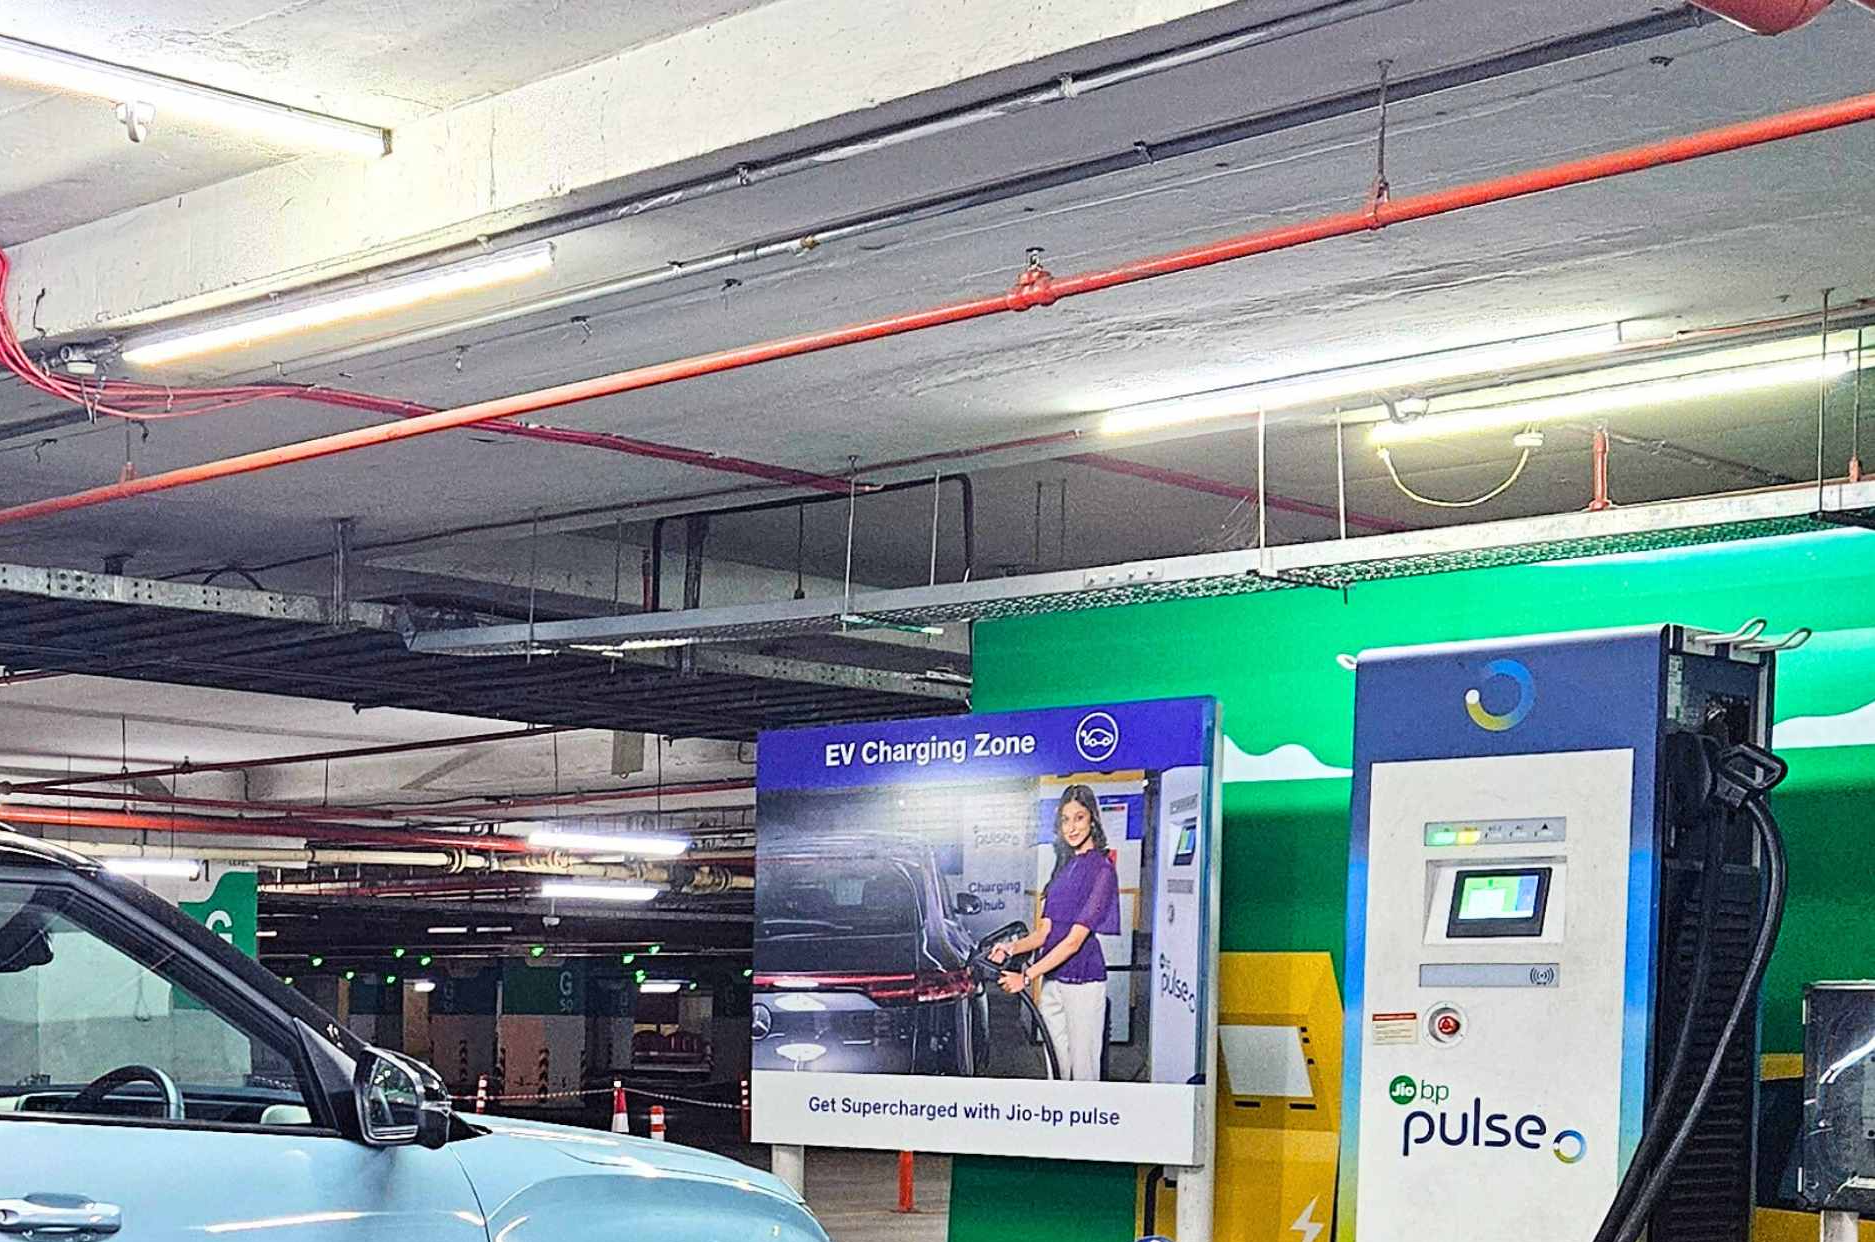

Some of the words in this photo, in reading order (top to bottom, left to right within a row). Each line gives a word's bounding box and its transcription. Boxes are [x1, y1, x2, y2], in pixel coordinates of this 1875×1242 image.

[825, 743, 855, 767] EV
[861, 736, 967, 765] Charging
[974, 732, 1036, 757] Zone
[968, 881, 1021, 895] Charging
[984, 899, 1006, 911] hub
[559, 971, 574, 996] G
[1391, 1083, 1415, 1097] Jio
[1420, 1079, 1449, 1104] bp
[809, 1096, 836, 1113] Get
[841, 1097, 958, 1121] Supercharged
[963, 1102, 1000, 1121] with
[1006, 1104, 1063, 1126] Jio-bp
[1069, 1107, 1120, 1127] pulse
[1402, 1097, 1547, 1157] pulse
